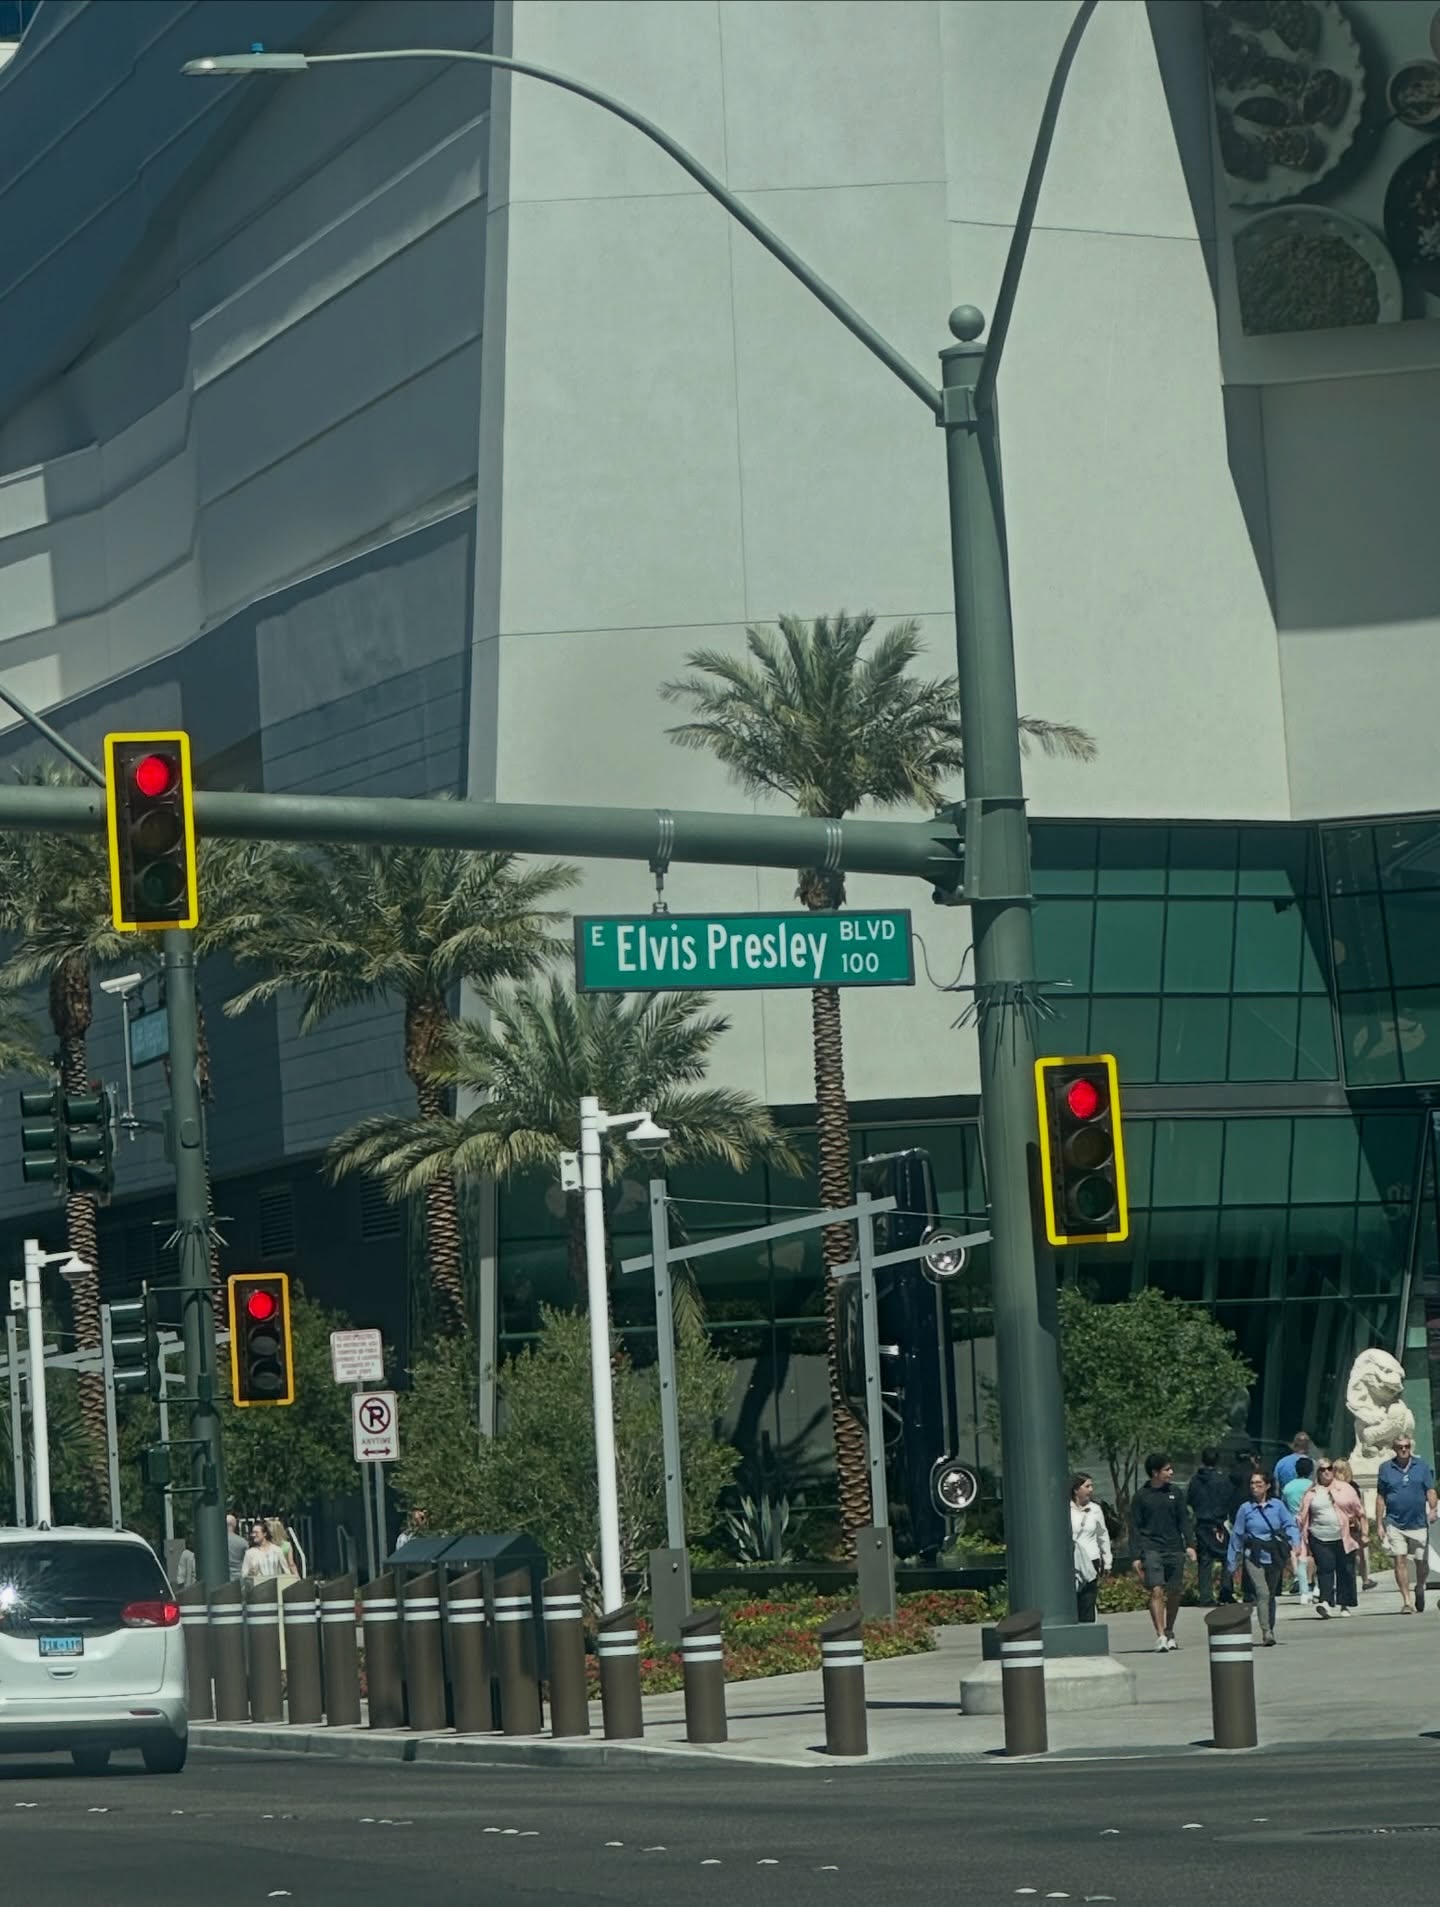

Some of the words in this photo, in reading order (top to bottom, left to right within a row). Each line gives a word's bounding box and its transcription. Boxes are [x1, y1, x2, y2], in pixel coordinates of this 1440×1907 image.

[839, 920, 896, 942] BLVD
[591, 926, 605, 947] E
[617, 923, 697, 972] Elvis
[707, 922, 828, 980] Presley
[841, 953, 880, 974] 100
[361, 1436, 392, 1446] ANYTIME
